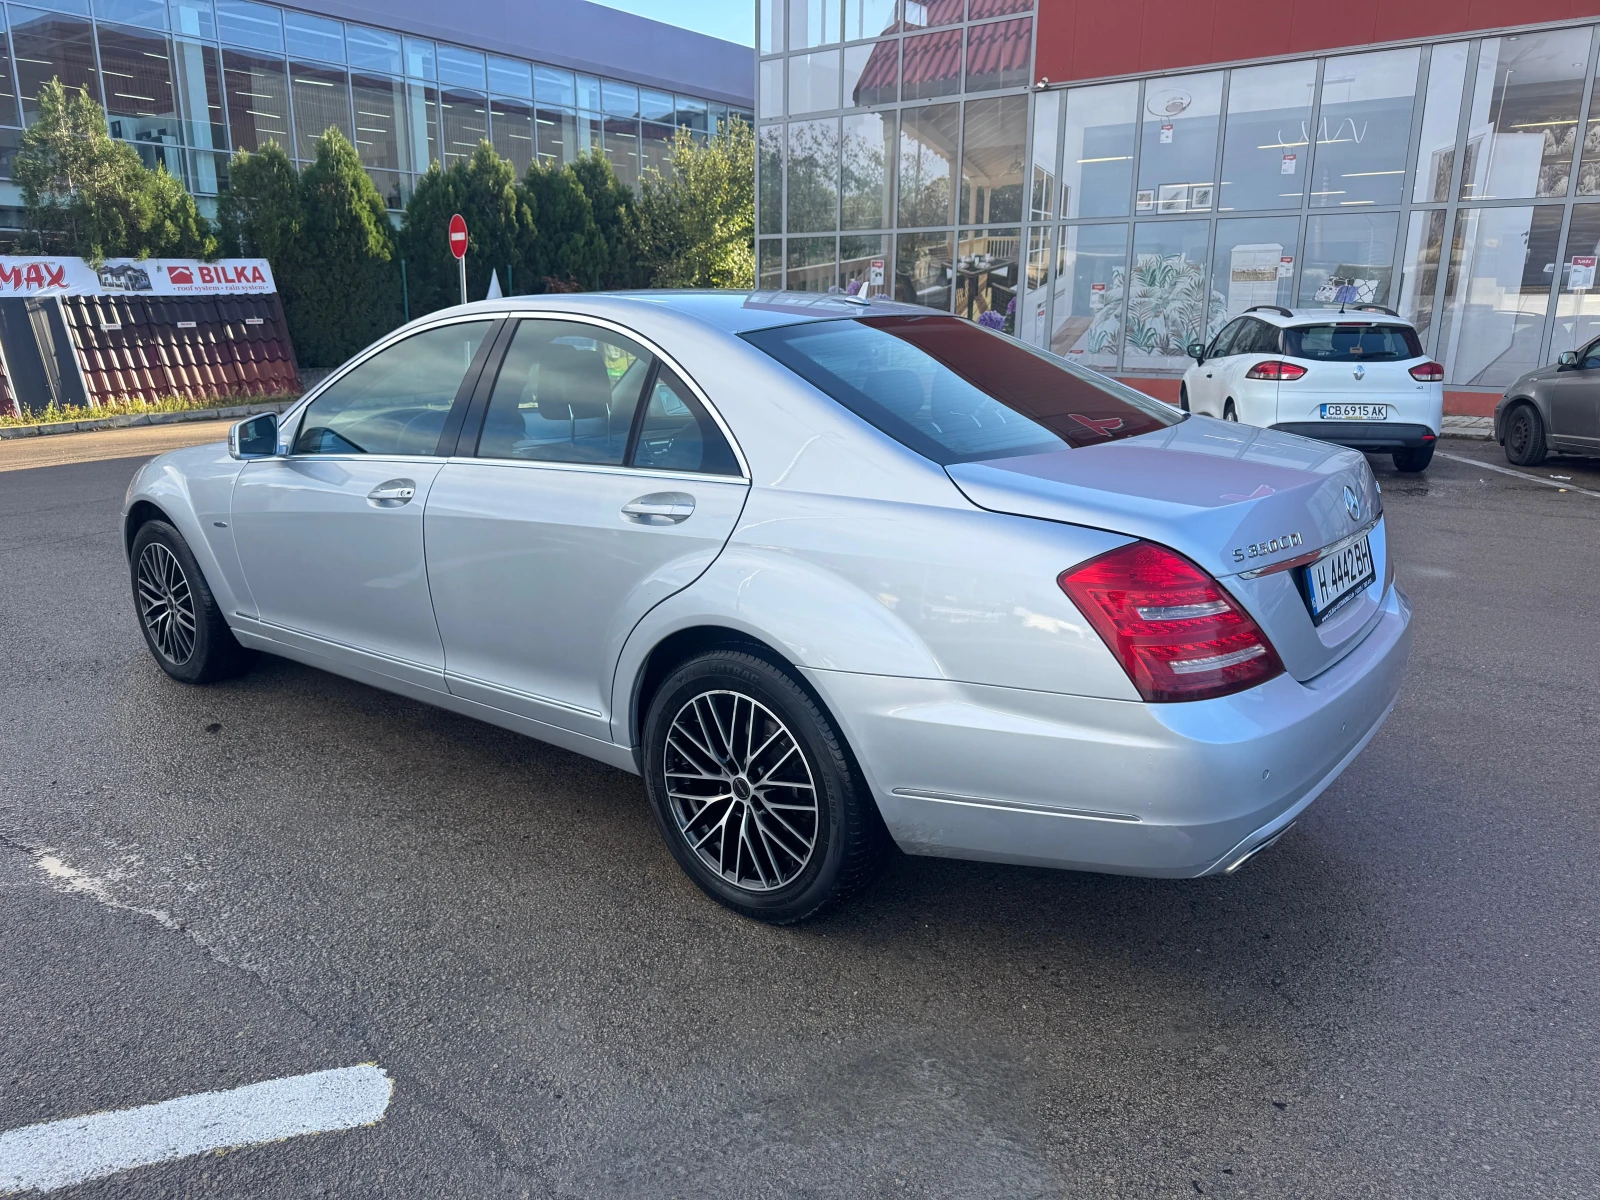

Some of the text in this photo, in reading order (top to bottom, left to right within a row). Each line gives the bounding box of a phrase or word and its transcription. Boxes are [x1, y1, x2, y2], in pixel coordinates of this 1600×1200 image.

[0, 263, 70, 291] MAX
[198, 266, 266, 283] BILKA
[241, 284, 265, 292] system
